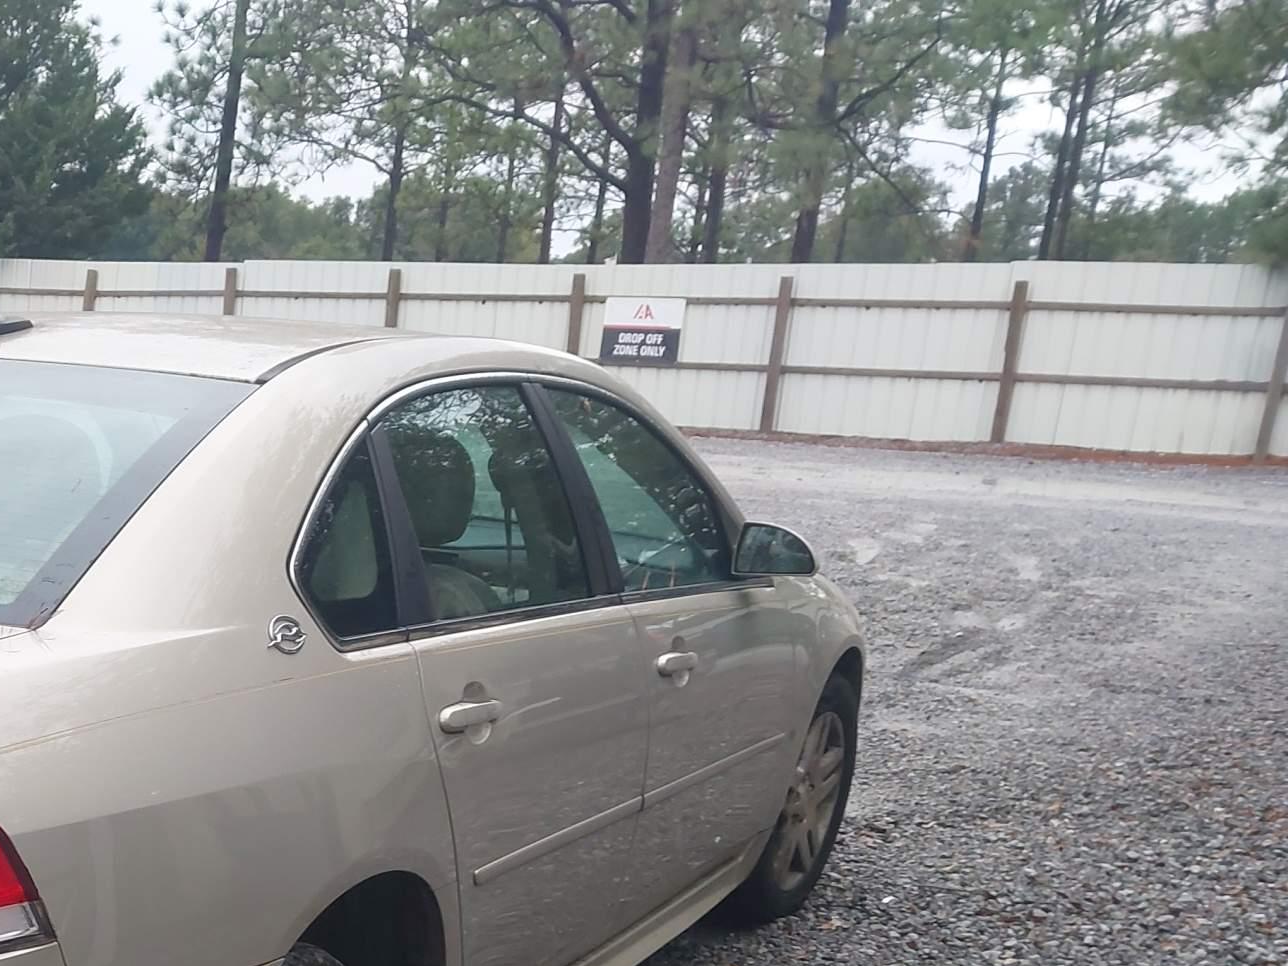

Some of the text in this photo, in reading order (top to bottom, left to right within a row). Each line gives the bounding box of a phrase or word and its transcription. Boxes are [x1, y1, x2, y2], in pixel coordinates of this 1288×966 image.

[618, 332, 664, 344] DROP OFF
[613, 344, 666, 357] ZONE ONLY
